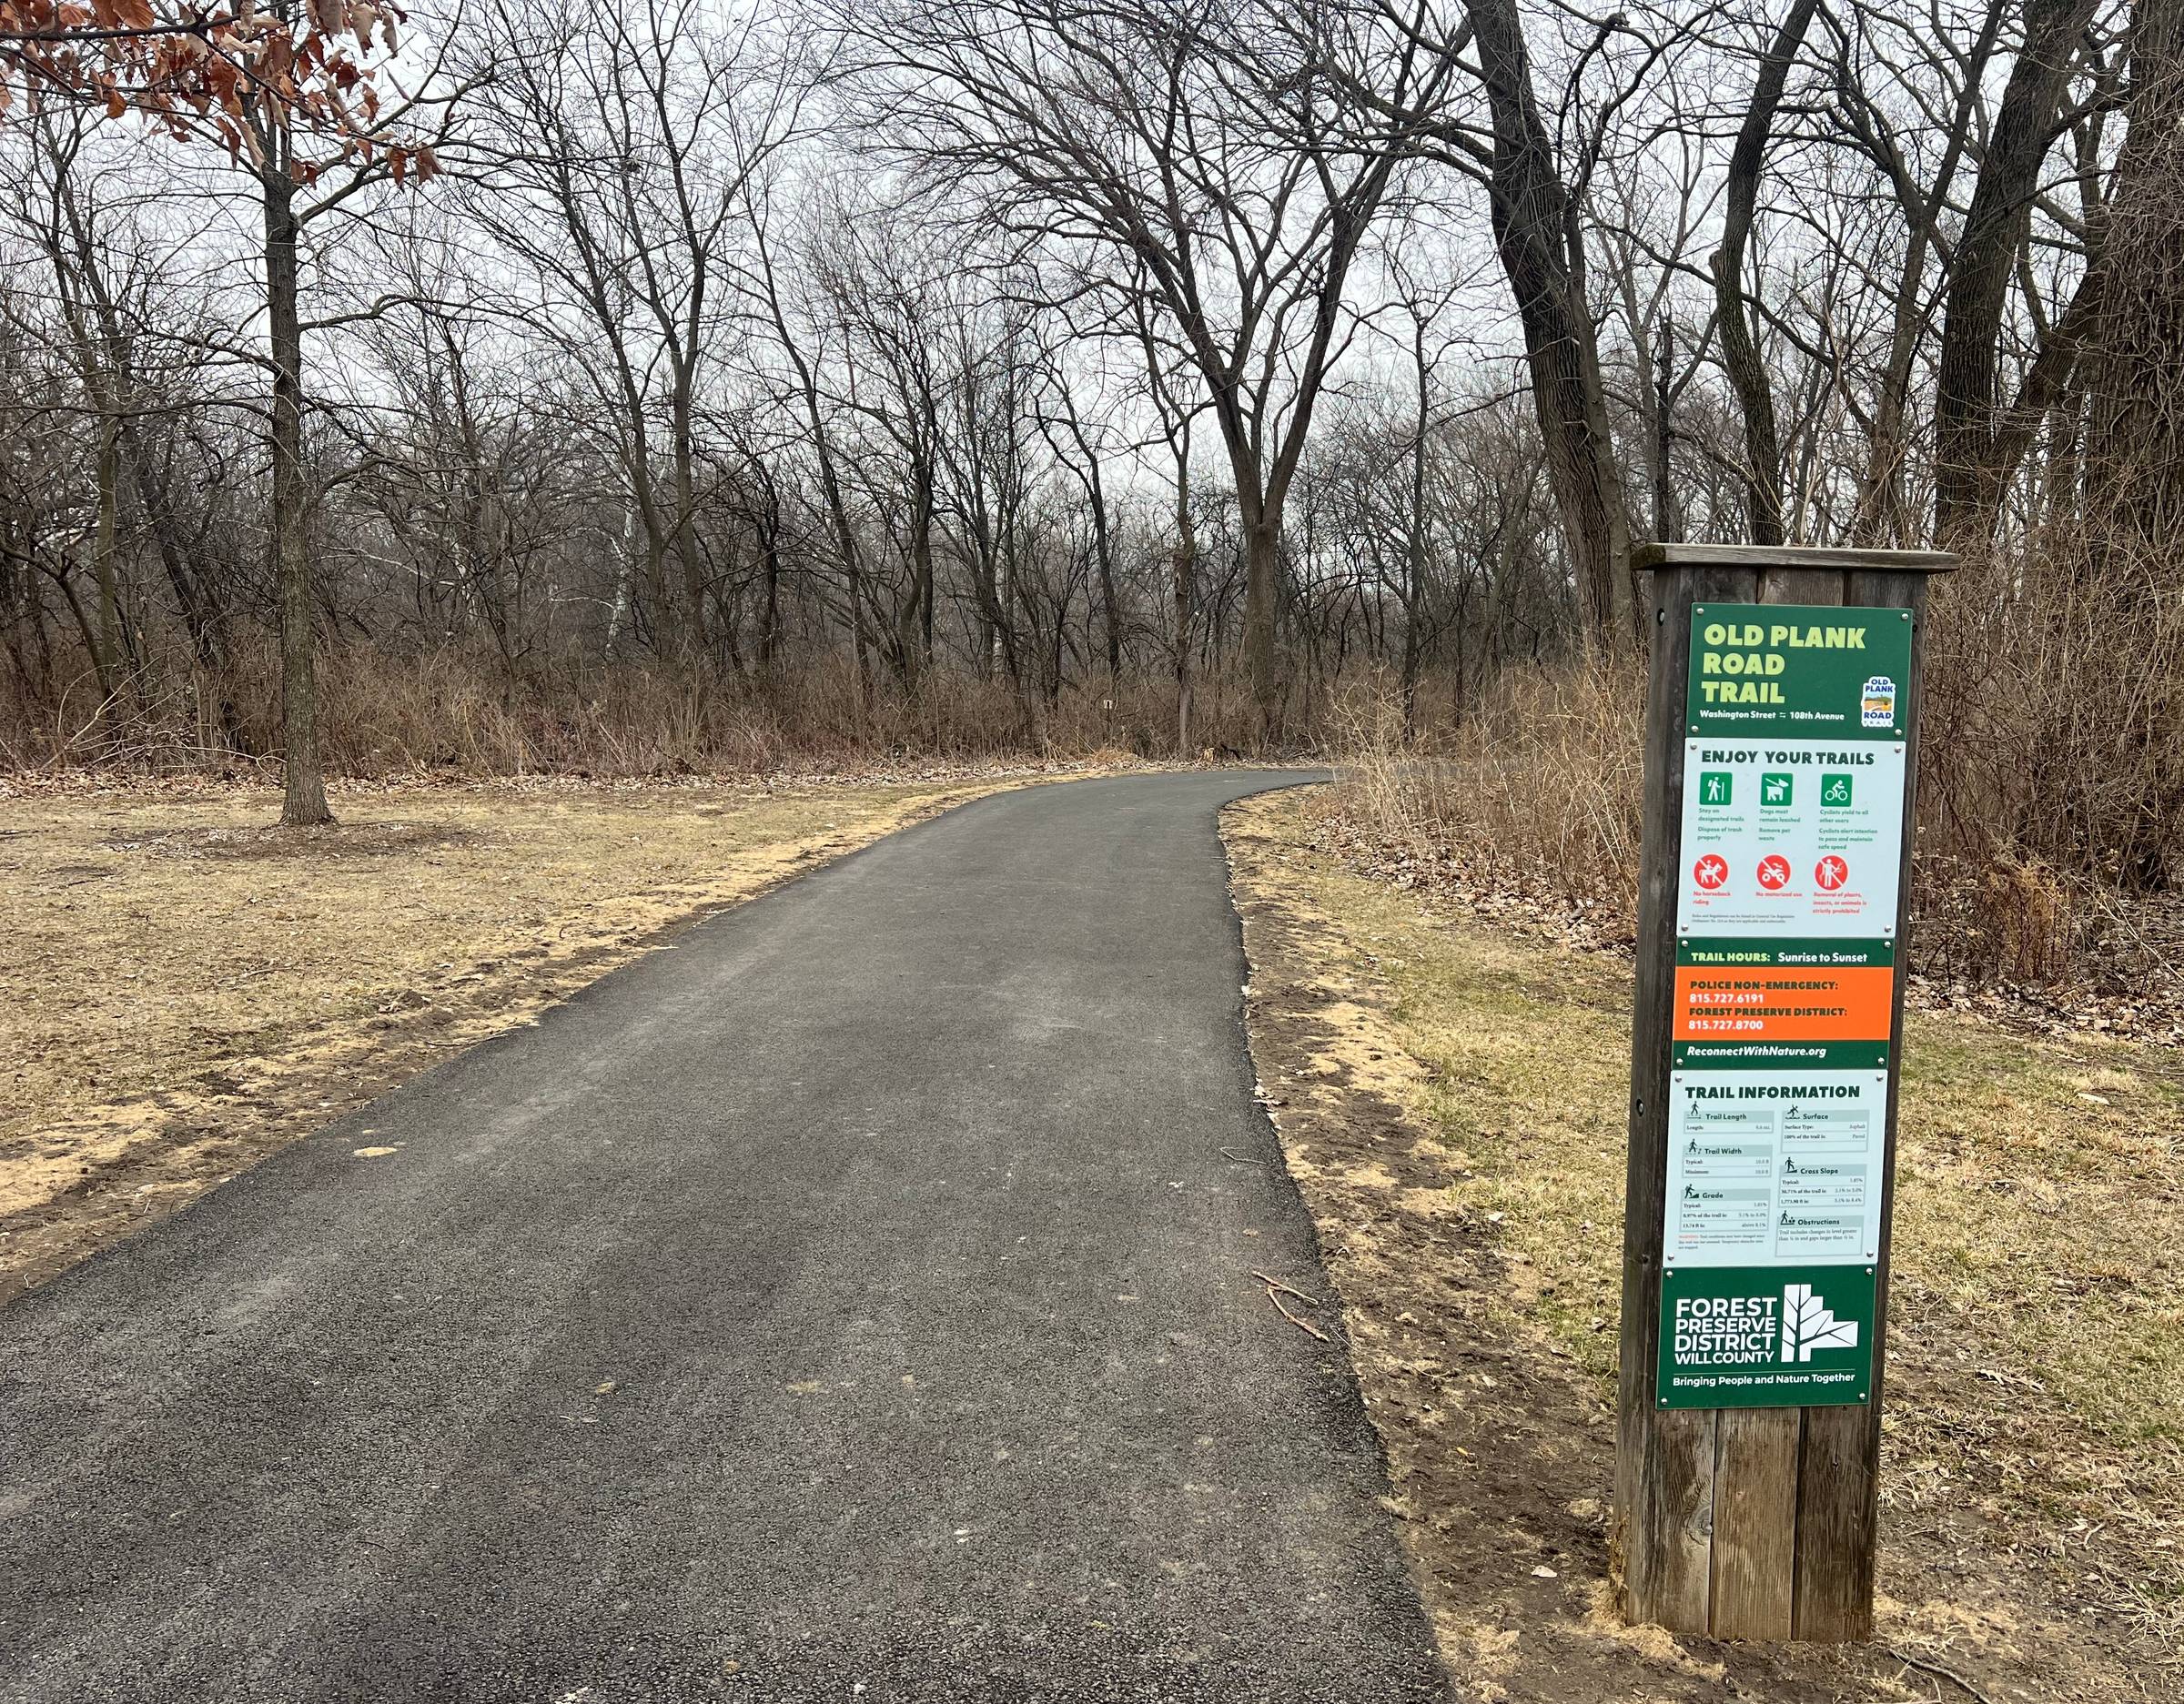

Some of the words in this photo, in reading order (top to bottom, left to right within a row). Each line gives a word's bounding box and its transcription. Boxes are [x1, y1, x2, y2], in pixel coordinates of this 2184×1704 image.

[1704, 624, 1764, 646] OLD
[1771, 626, 1866, 649] PLANK
[1704, 652, 1785, 675] ROAD
[1701, 681, 1785, 703] TRAIL
[1700, 710, 1749, 720] Washington
[1751, 711, 1776, 719] Street
[1790, 711, 1813, 720] 108th
[1815, 712, 1845, 721] Avenue
[1702, 751, 1759, 762] ENJOY
[1765, 751, 1811, 764] YOUR
[1816, 752, 1875, 765] TRAILS
[1691, 953, 1724, 962] TRAIL
[1727, 953, 1770, 962] HOURS:
[1778, 953, 1817, 963] Sunrise
[1819, 953, 1830, 963] to
[1833, 953, 1867, 963] Sunset
[1690, 981, 1732, 989] POLICE
[1734, 982, 1838, 990] NON-EMERGENCY:
[1690, 994, 1764, 1003] 815.727.6191
[1734, 1008, 1792, 1016] PRESERVE
[1794, 1008, 1847, 1016] DISTRICT:
[1689, 1021, 1764, 1030] 815.727.8700
[1687, 1046, 1826, 1058] ReconnectWithNature.org
[1685, 1087, 1734, 1099] TRAIL
[1738, 1086, 1860, 1098] INFORMATION
[1676, 1297, 1777, 1317] FOREST
[1676, 1317, 1776, 1334] PRESERVE
[1675, 1333, 1775, 1352] DISTRICT
[1675, 1353, 1712, 1365] WILL
[1713, 1351, 1774, 1364] COUNTY
[1673, 1377, 1716, 1386] Bringing
[1719, 1376, 1753, 1386] People
[1754, 1376, 1773, 1385] and
[1776, 1375, 1809, 1383] Nature
[1812, 1374, 1855, 1384] Together
